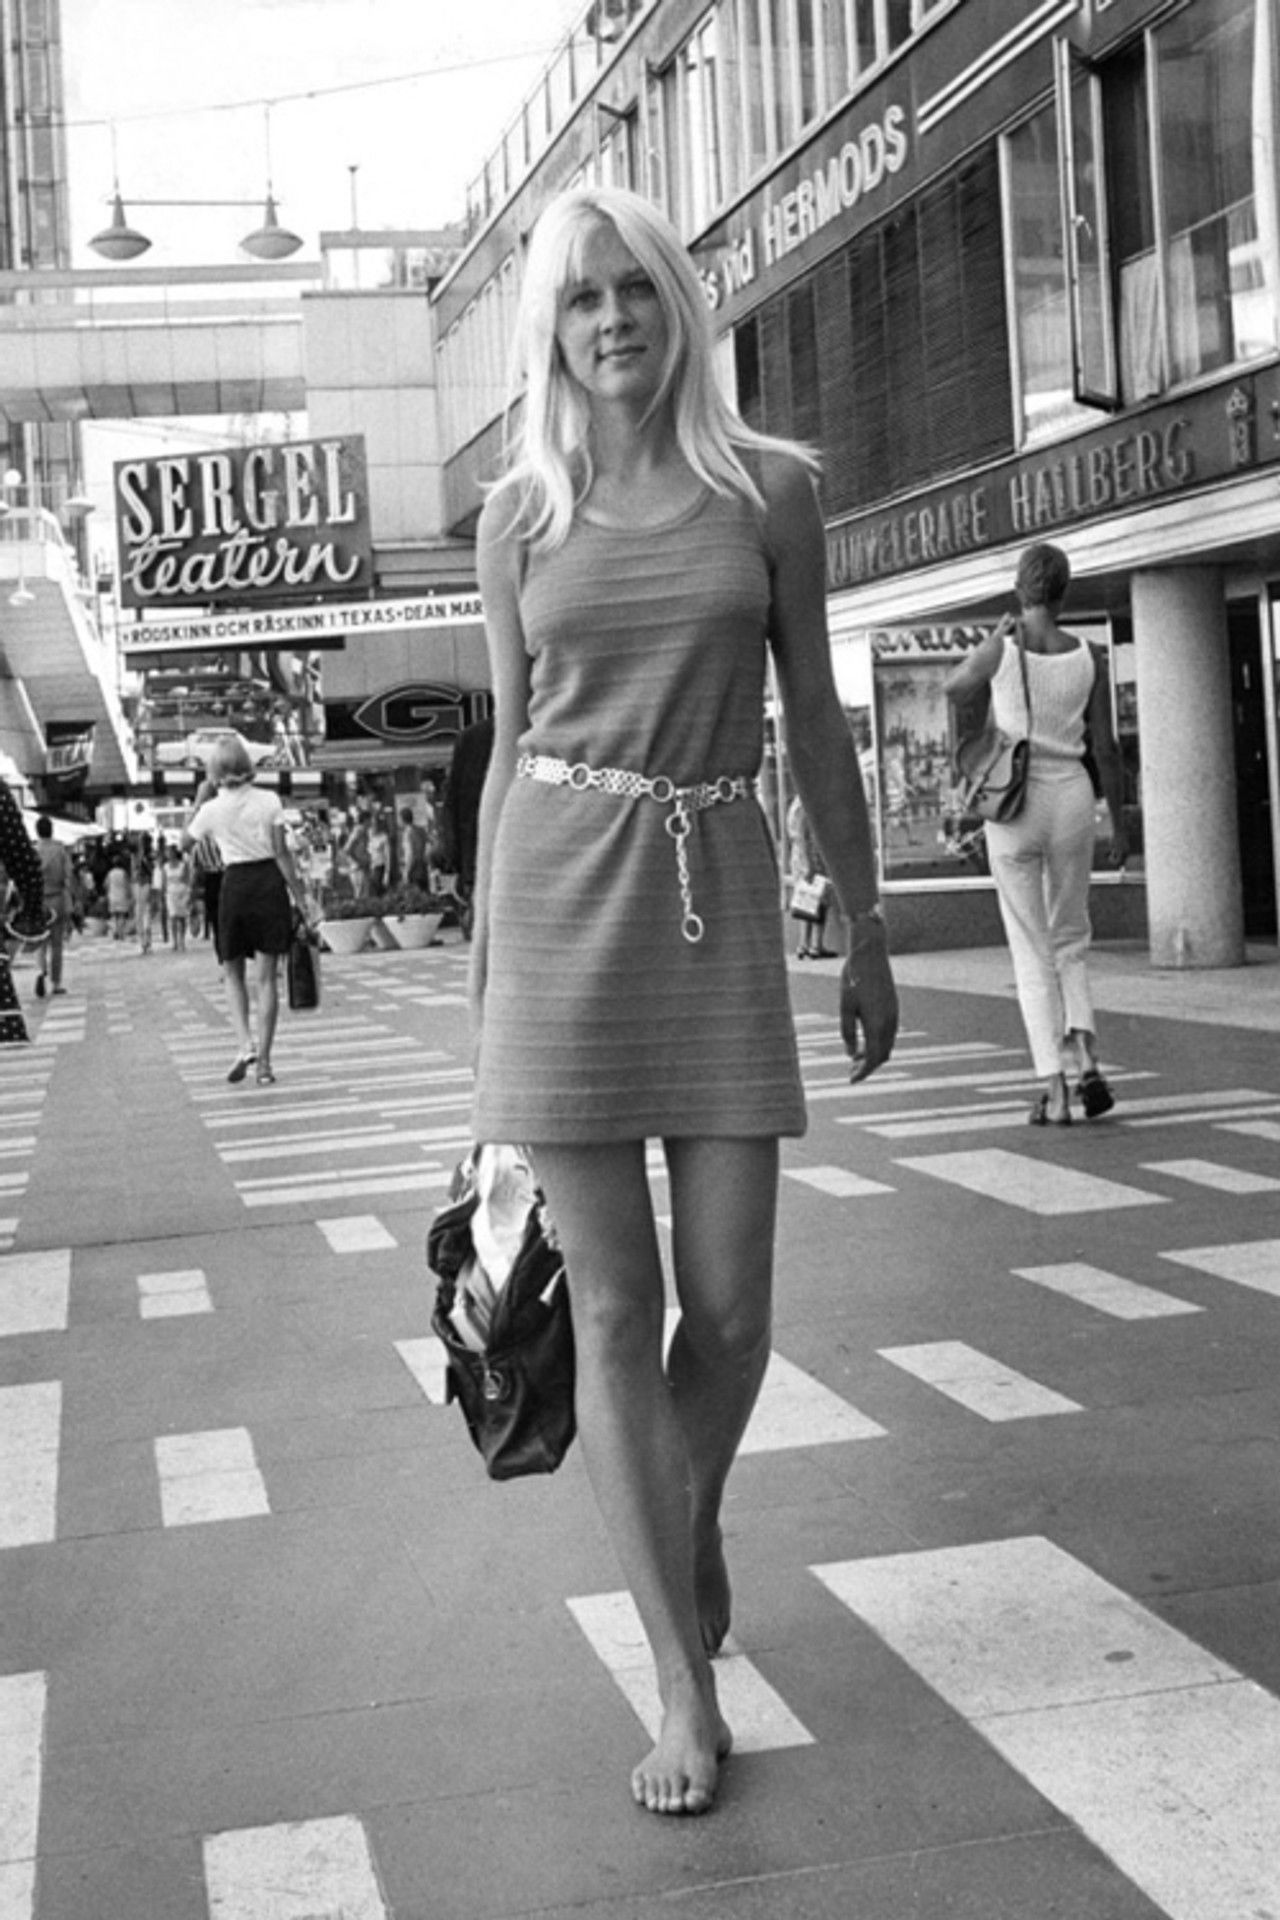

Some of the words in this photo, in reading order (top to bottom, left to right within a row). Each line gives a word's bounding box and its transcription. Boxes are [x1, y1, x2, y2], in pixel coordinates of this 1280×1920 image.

[763, 105, 907, 267] HERMODS
[118, 441, 355, 544] SERGEL
[1010, 419, 1191, 533] HALLBERG
[122, 527, 359, 597] teatern
[215, 620, 249, 637] OCH
[253, 614, 324, 633] RÅSKINN
[340, 607, 396, 626] TEXAS
[404, 604, 446, 622] DEAN
[450, 600, 483, 616] MAR
